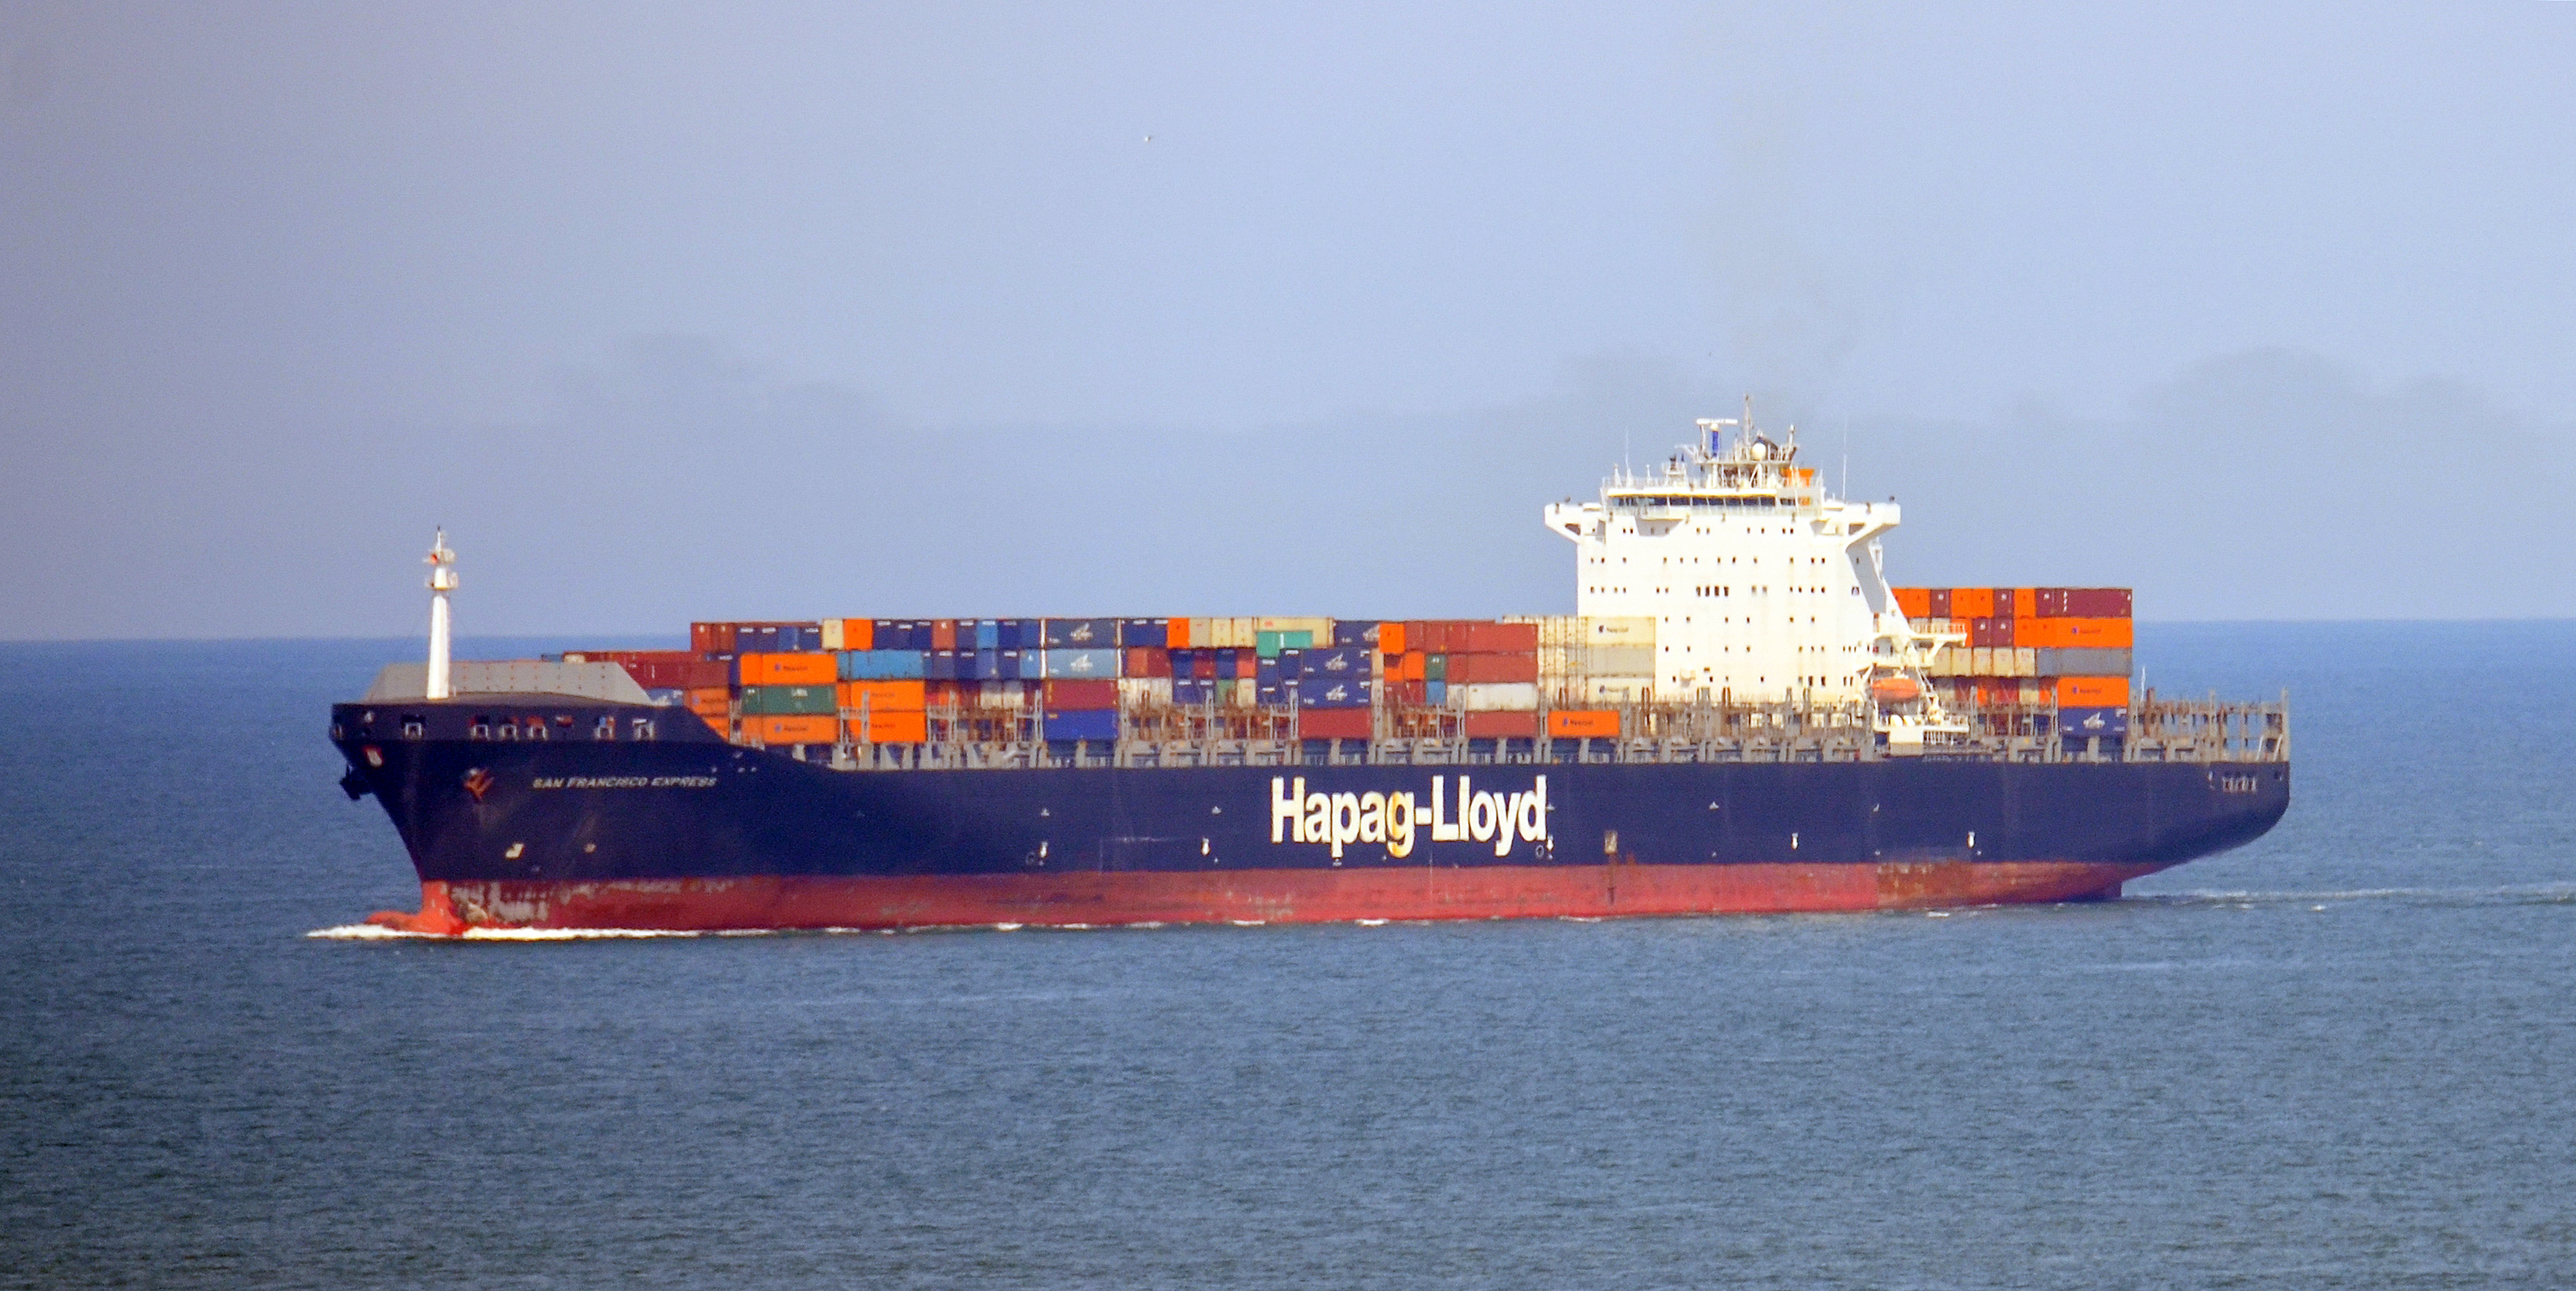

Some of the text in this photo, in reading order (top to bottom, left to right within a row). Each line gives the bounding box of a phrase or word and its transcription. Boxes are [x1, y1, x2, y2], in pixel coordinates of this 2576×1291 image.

[533, 777, 717, 787] SAN FRANCISCO EXPRESS
[1271, 775, 1547, 857] Hapag-Lloyd
